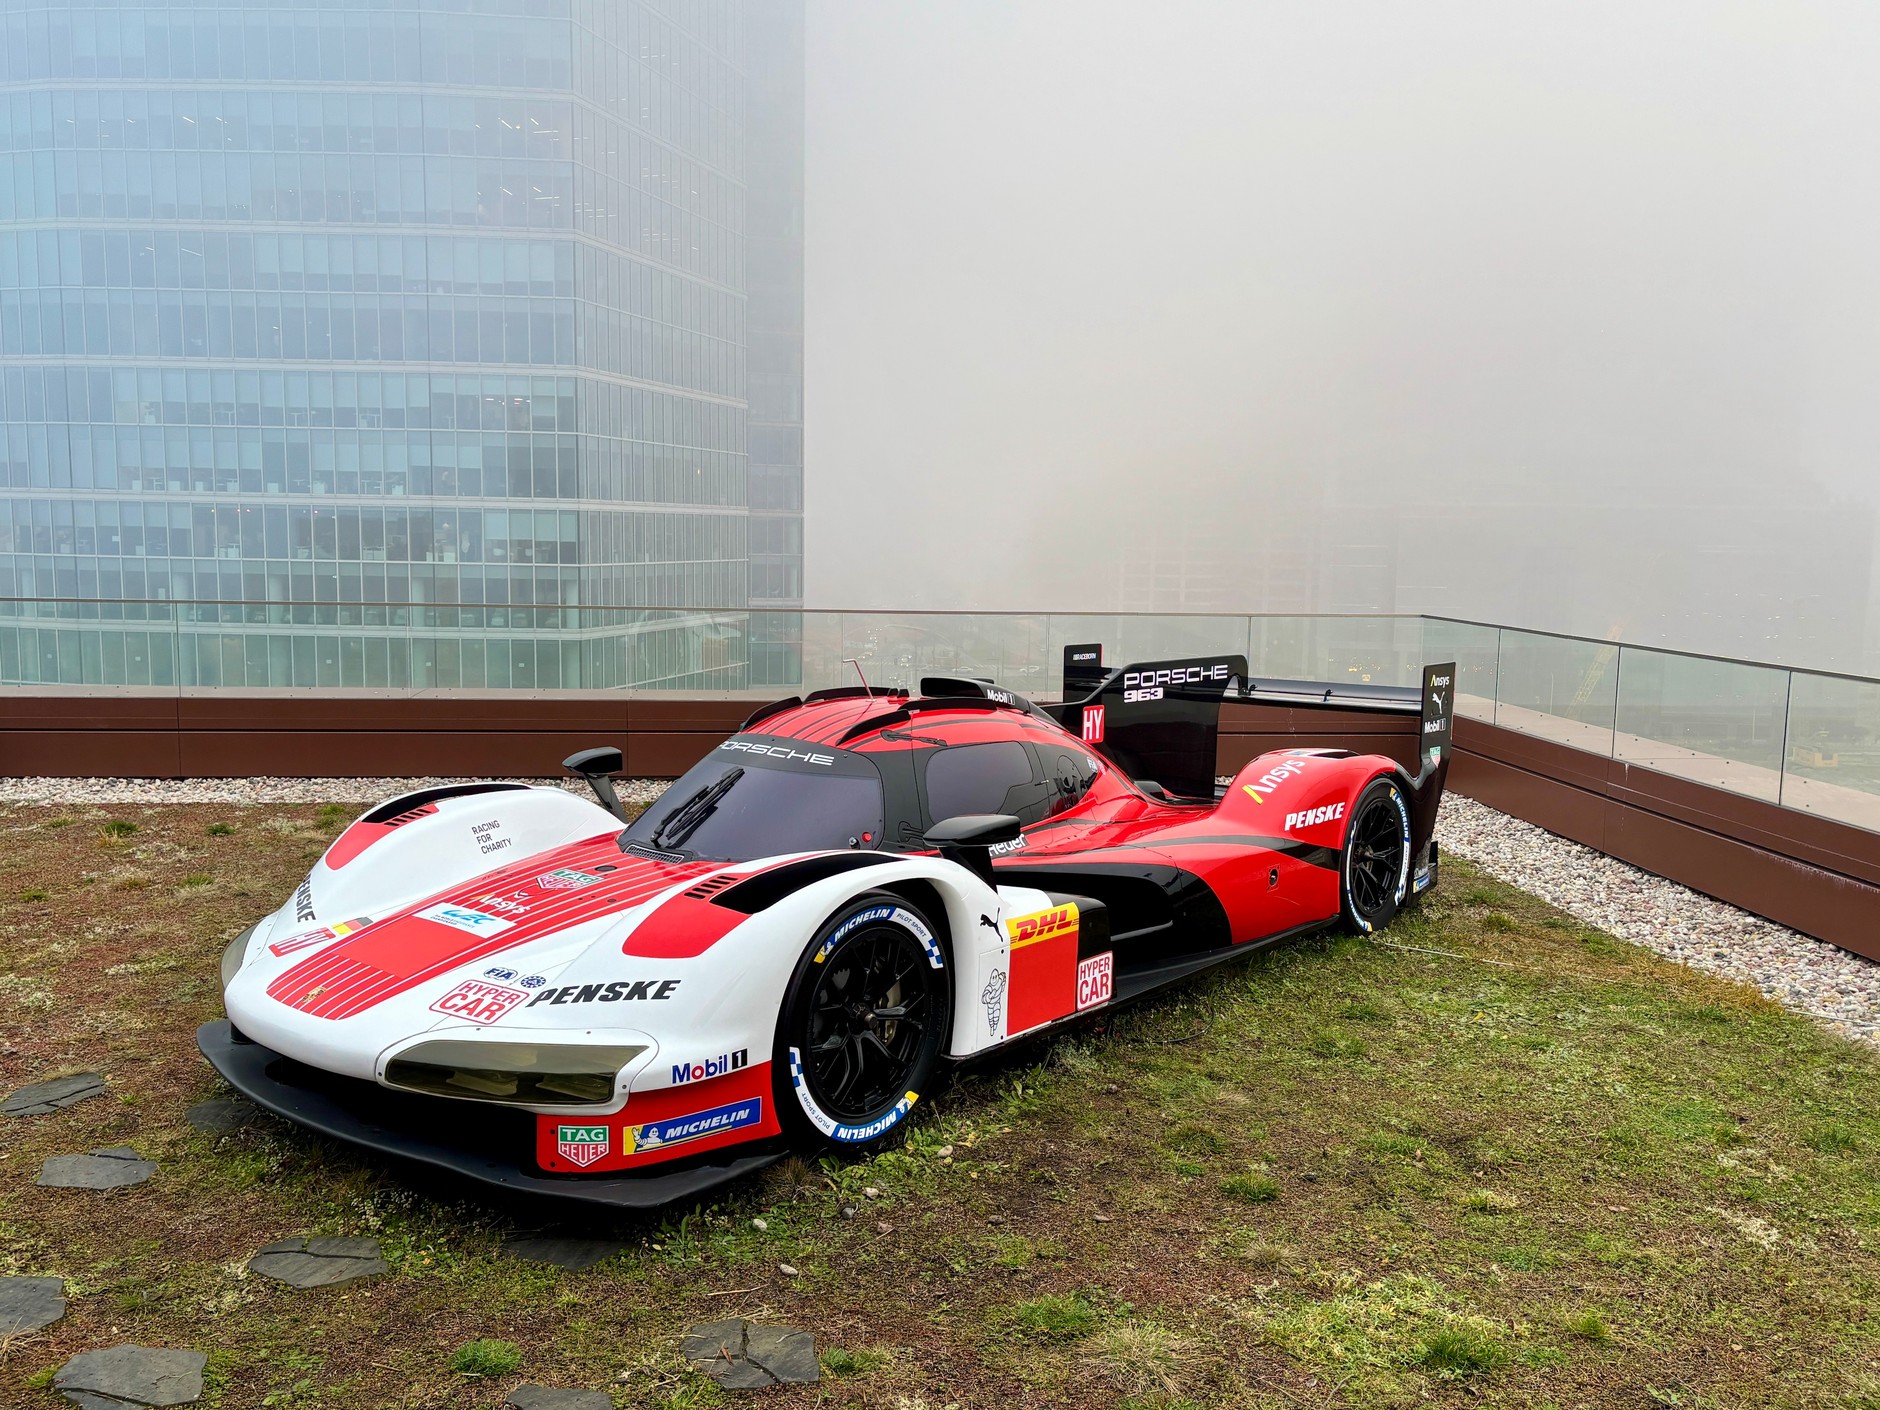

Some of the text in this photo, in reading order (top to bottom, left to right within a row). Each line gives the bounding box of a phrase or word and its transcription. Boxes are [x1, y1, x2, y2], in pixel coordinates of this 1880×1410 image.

[1124, 665, 1228, 688] PORSCHE
[1431, 675, 1449, 688] Ansys
[987, 689, 1008, 703] Mobil
[1124, 688, 1163, 702] 963
[1084, 709, 1103, 740] HY
[1424, 719, 1440, 733] Mobil
[1242, 760, 1306, 804] Ansys
[472, 820, 500, 835] RACING
[1284, 802, 1345, 831] PENSKE
[1396, 798, 1408, 838] MICHELIN
[477, 833, 493, 844] FOR
[481, 838, 512, 854] CHARITY
[471, 893, 531, 914] Ansys
[834, 908, 927, 942] MICHELIN PILOT SPORT
[1017, 910, 1072, 942] DHL
[485, 968, 514, 979] FIA
[1080, 956, 1110, 981] HYPER
[458, 982, 522, 1005] HYPER
[525, 979, 682, 1008] PENSKE
[1079, 974, 1110, 1005] CAR
[439, 993, 504, 1022] CAR
[672, 1055, 728, 1084] Mobil
[664, 1108, 750, 1139] MICHELIN
[801, 1092, 897, 1139] MICHELIN PILOT SPORT
[562, 1128, 605, 1141] TAG
[561, 1143, 606, 1163] HEUER
